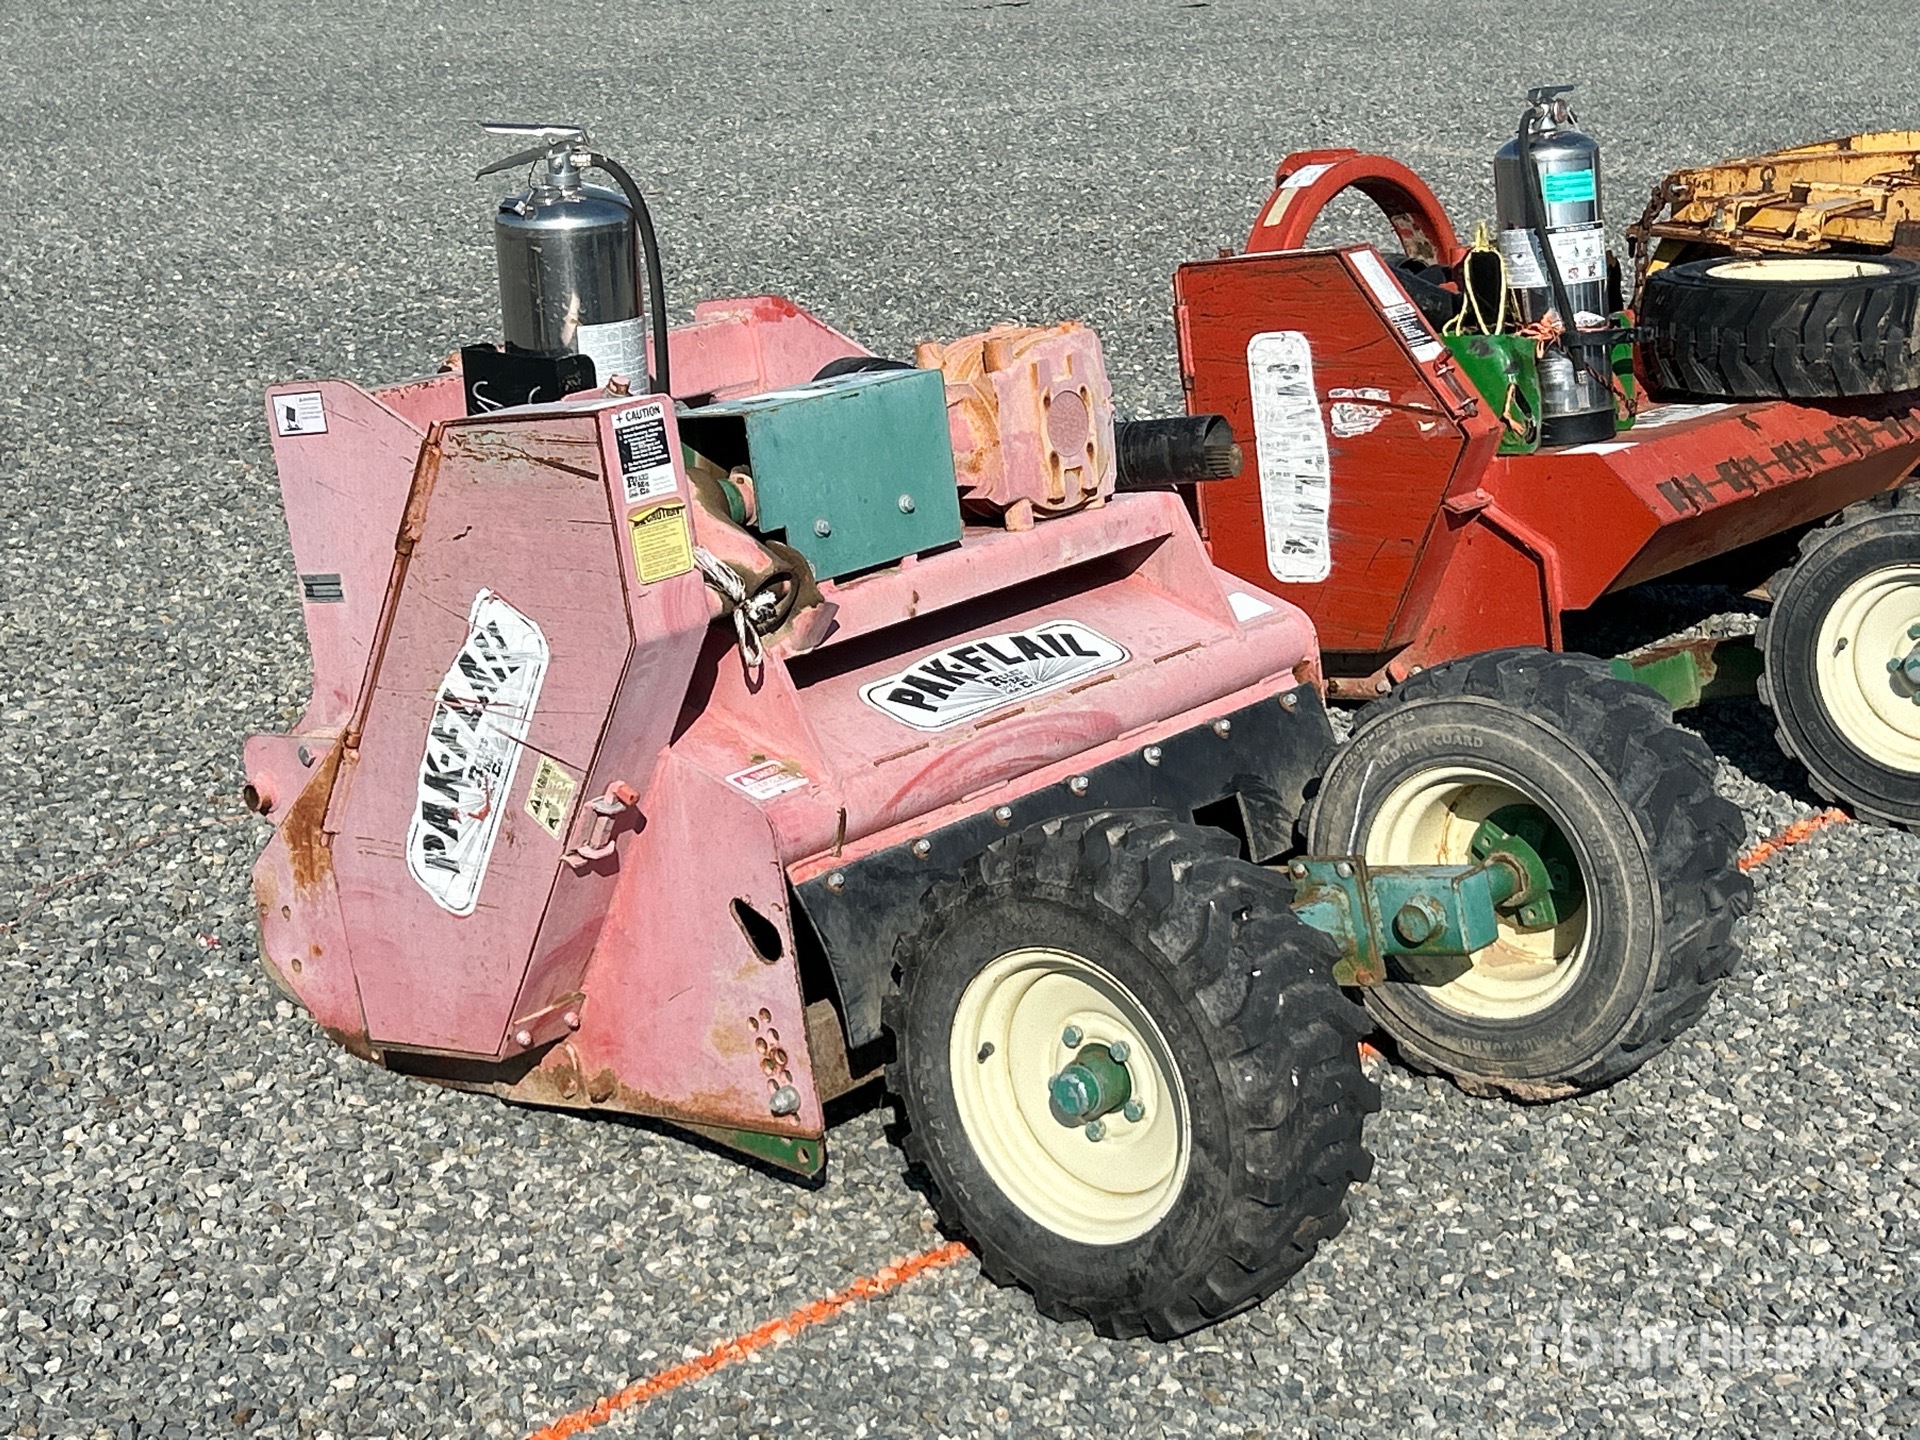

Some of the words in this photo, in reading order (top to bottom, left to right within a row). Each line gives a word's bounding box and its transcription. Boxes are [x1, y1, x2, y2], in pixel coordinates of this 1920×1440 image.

[625, 405, 661, 422] CAUTION
[886, 633, 1101, 713] PAK-FLAIL
[1433, 733, 1483, 748] GUARD
